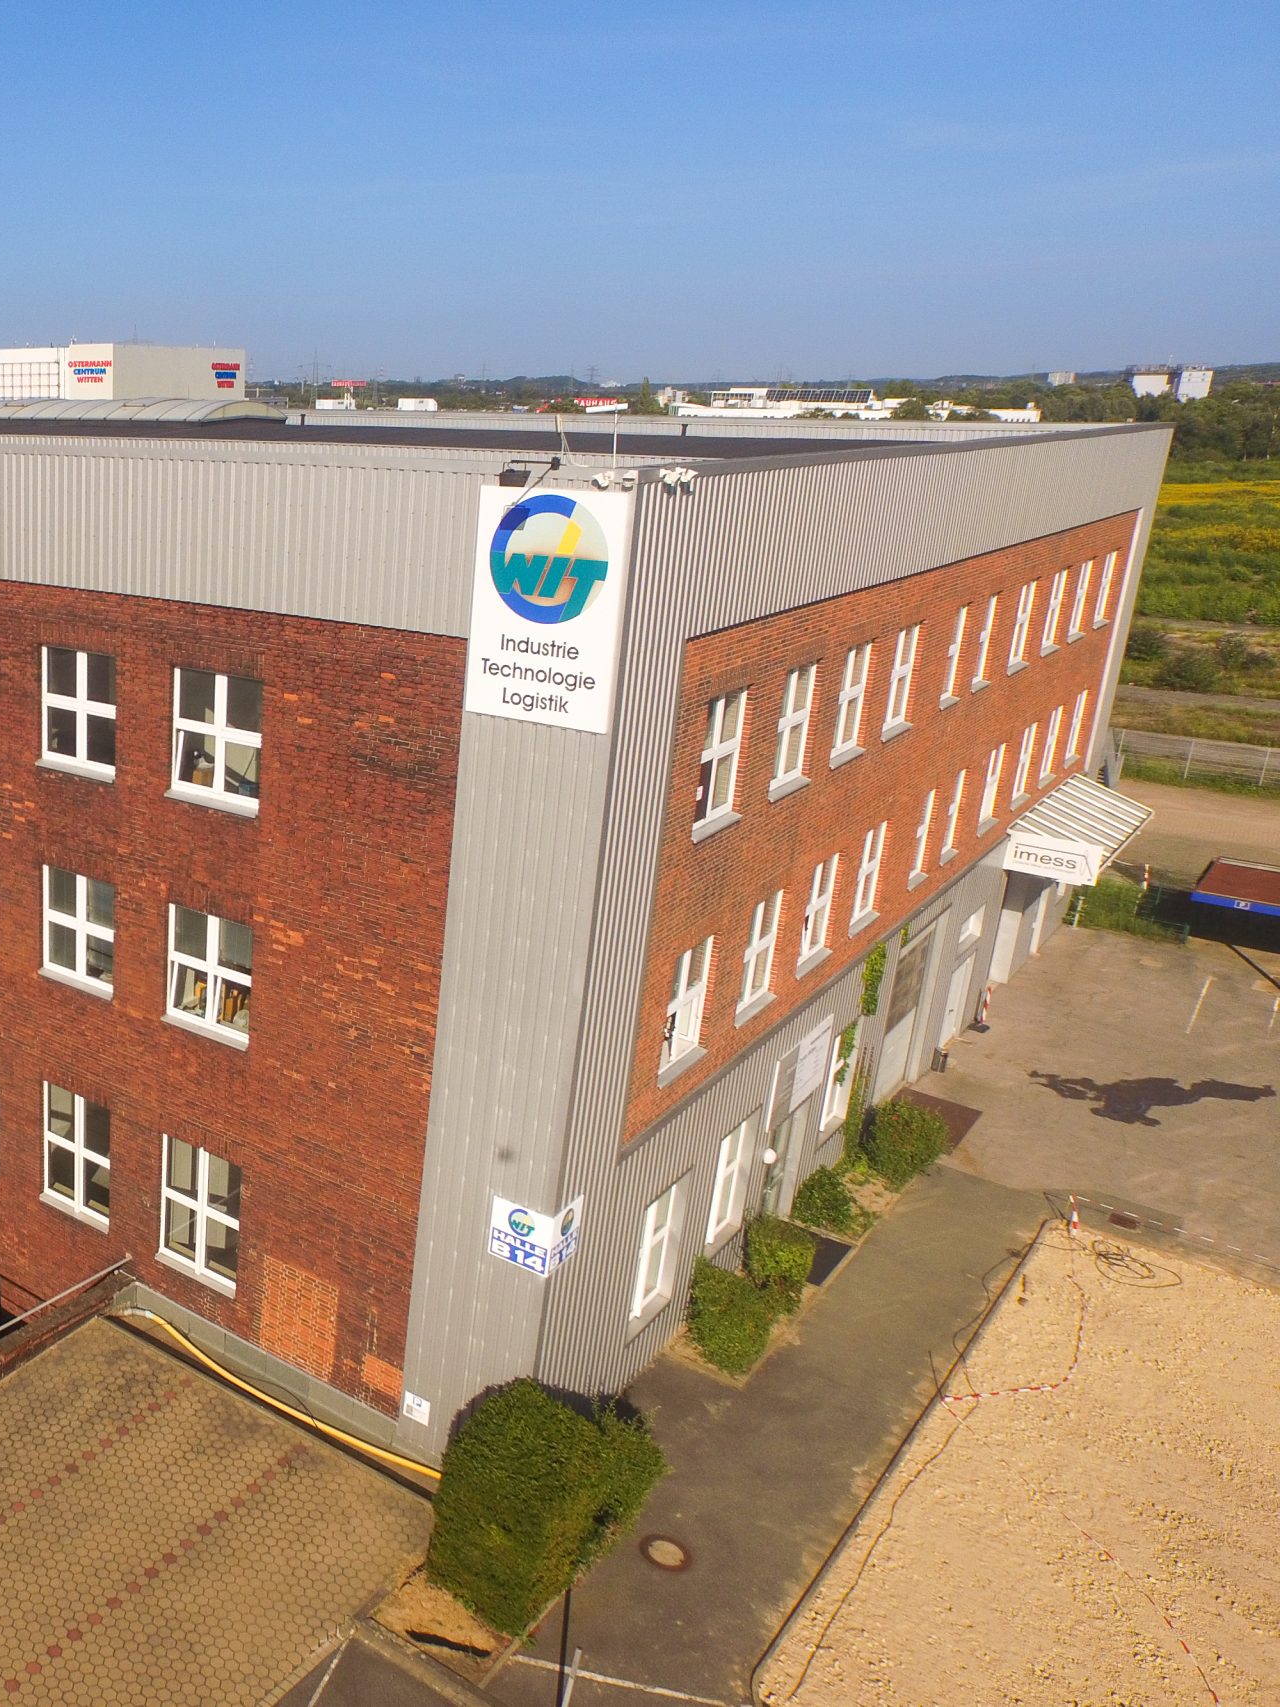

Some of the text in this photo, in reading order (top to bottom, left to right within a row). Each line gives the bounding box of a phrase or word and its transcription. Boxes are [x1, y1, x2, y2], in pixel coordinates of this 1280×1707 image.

[68, 360, 112, 368] OSTERMANN
[490, 551, 608, 622] WIT
[500, 634, 580, 660] Industrie
[481, 658, 596, 692] Technologie
[502, 687, 569, 714] Logistik
[1013, 846, 1077, 869] imess
[493, 1229, 546, 1258] HALLE
[514, 1250, 544, 1272] 14
